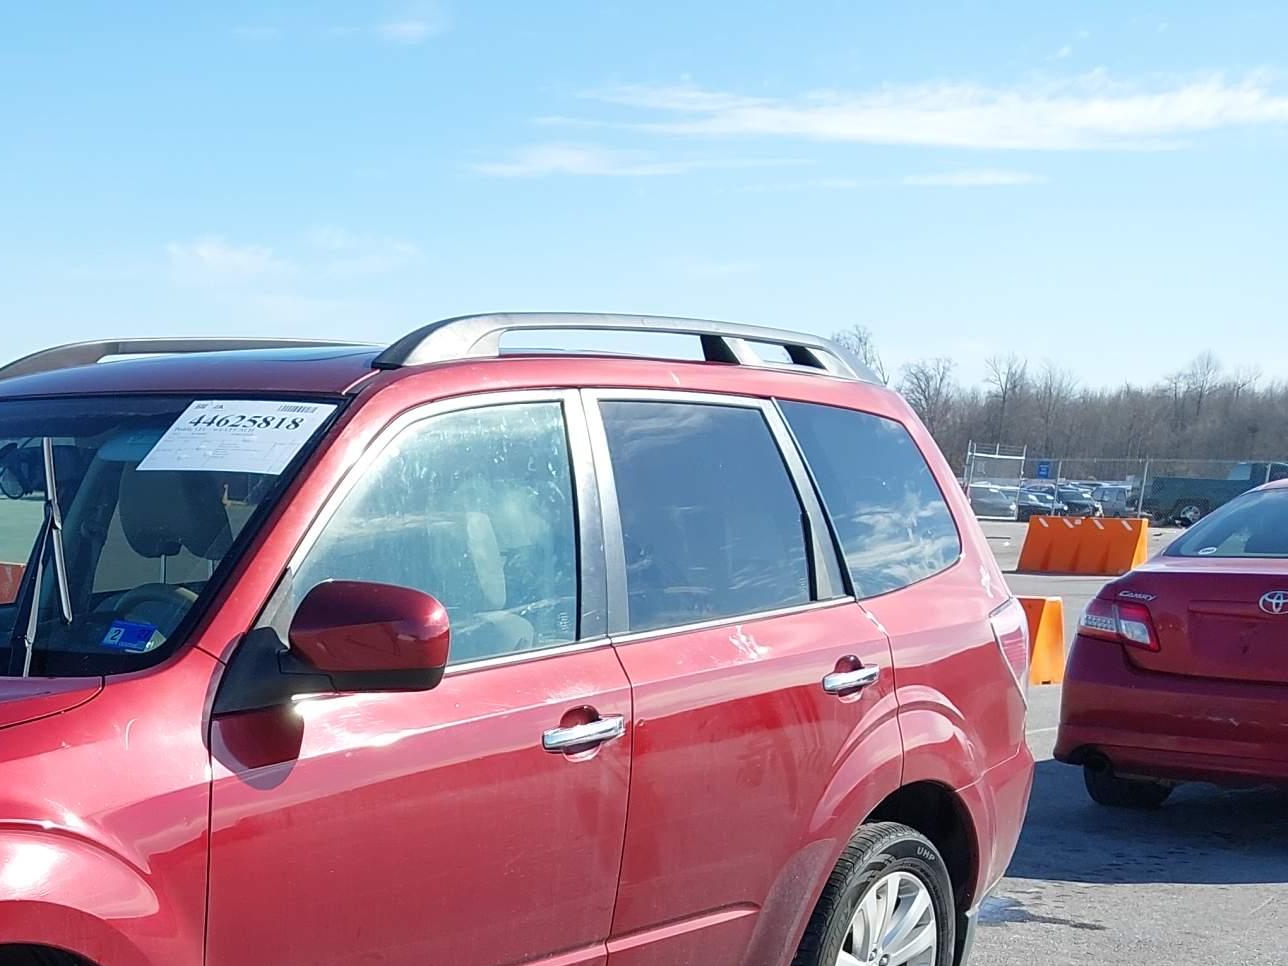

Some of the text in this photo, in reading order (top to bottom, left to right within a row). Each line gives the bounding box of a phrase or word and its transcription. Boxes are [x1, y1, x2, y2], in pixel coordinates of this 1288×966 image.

[188, 414, 304, 431] 44625818
[110, 629, 122, 641] 2
[916, 846, 935, 860] UHP
